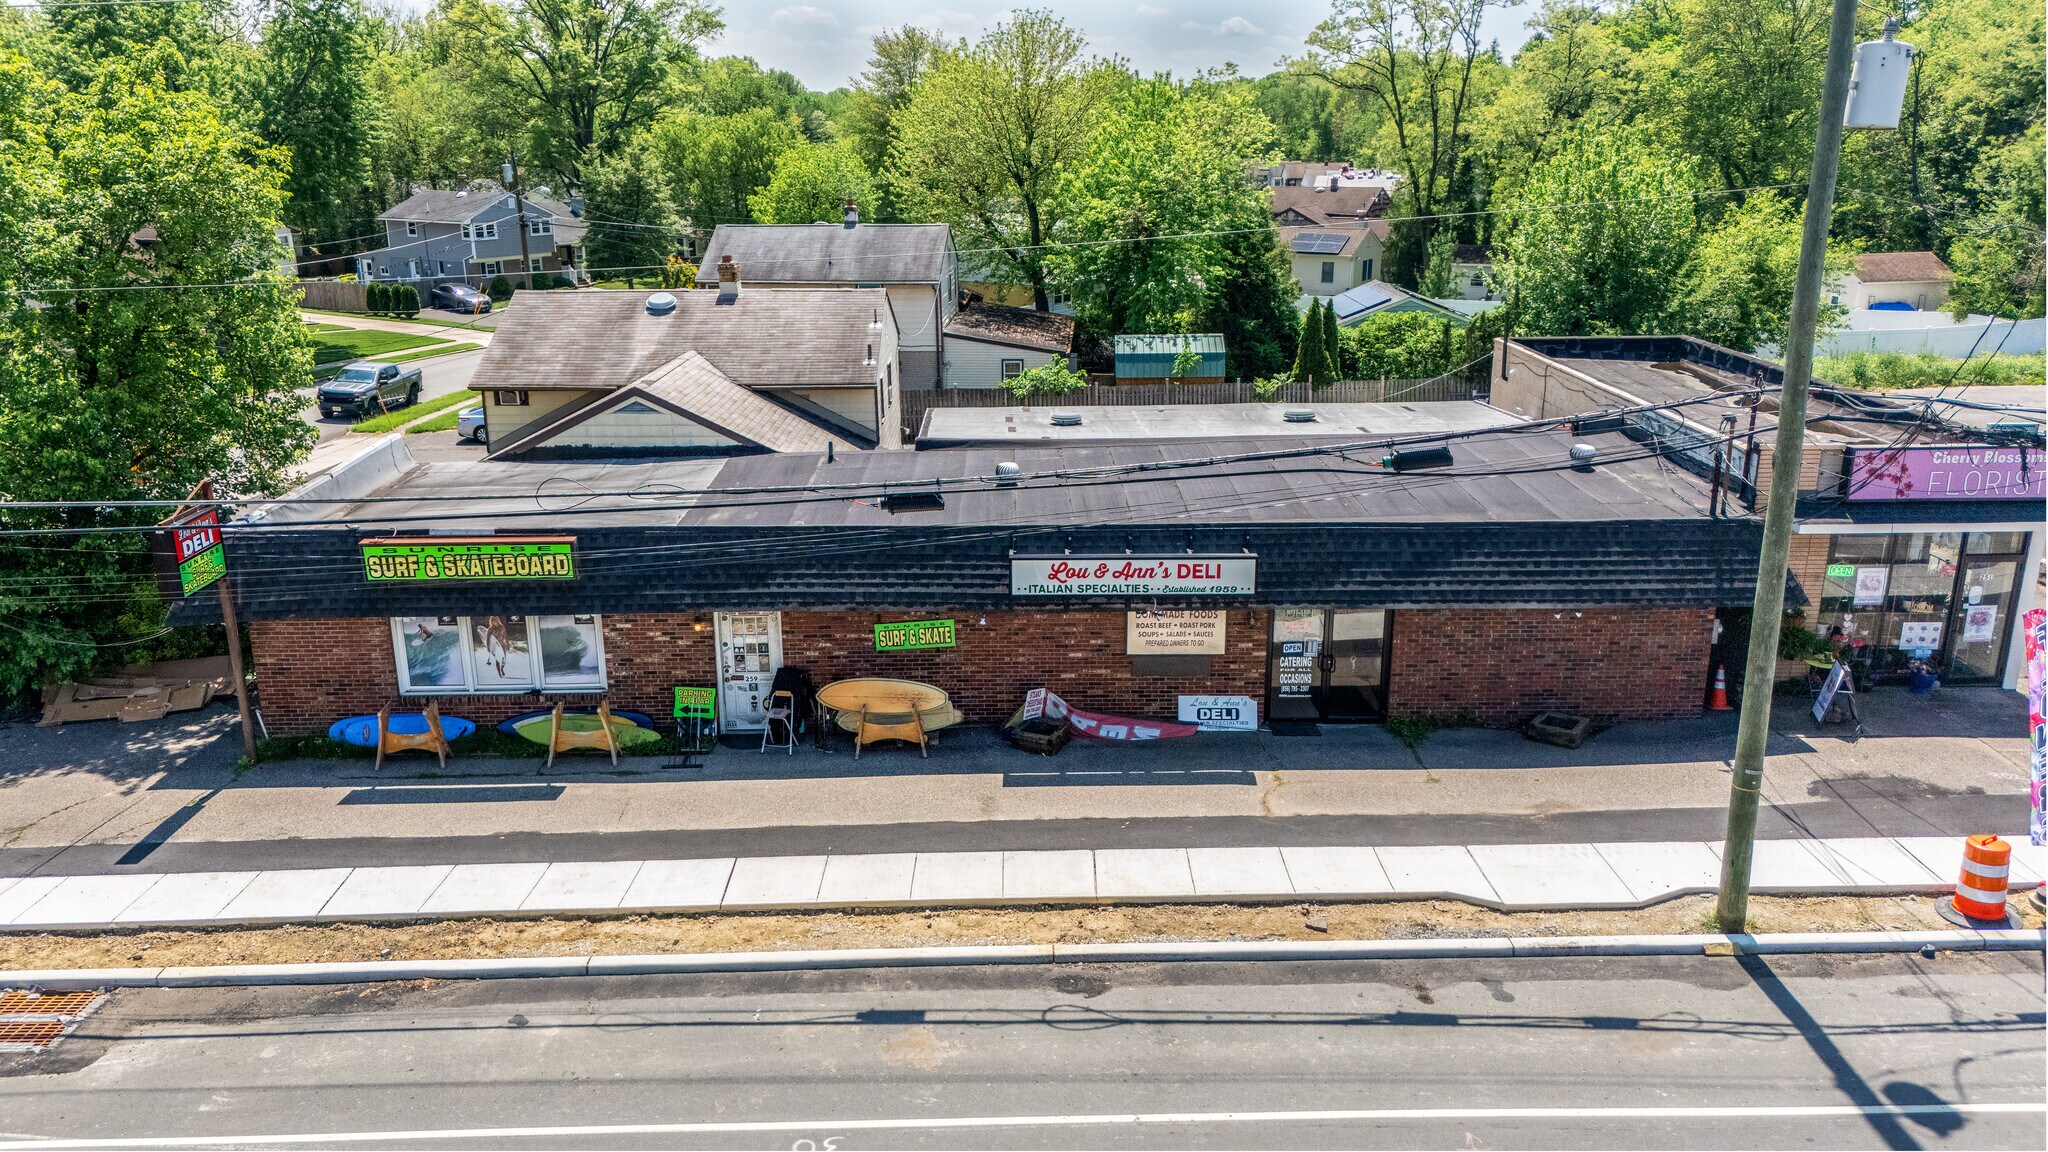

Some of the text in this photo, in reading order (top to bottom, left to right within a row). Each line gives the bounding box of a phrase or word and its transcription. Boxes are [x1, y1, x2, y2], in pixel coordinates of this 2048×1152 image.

[1933, 451, 1980, 467] Cherry
[1928, 470, 2046, 495] FLORIST
[182, 528, 214, 557] DELI
[181, 547, 220, 572] SUNRISE
[368, 553, 571, 578] SURF & SKATEBOARD
[1048, 561, 1221, 584] Lou & Ann's DELI
[1830, 566, 1852, 575] OPEN
[183, 564, 224, 592] SKATEBOARD
[1029, 584, 1238, 593] ITALIAN SPECIALTIES Established 1959
[1189, 610, 1218, 619] FOODS
[879, 626, 952, 647] SURF & SKATE
[1284, 644, 1302, 652] OPEN
[1280, 657, 1312, 667] CATERING
[1280, 673, 1312, 684] OCCASIONS
[678, 689, 712, 698] PARKING
[1189, 697, 1248, 707] Lou & Ann's
[1200, 708, 1237, 720] DELI
